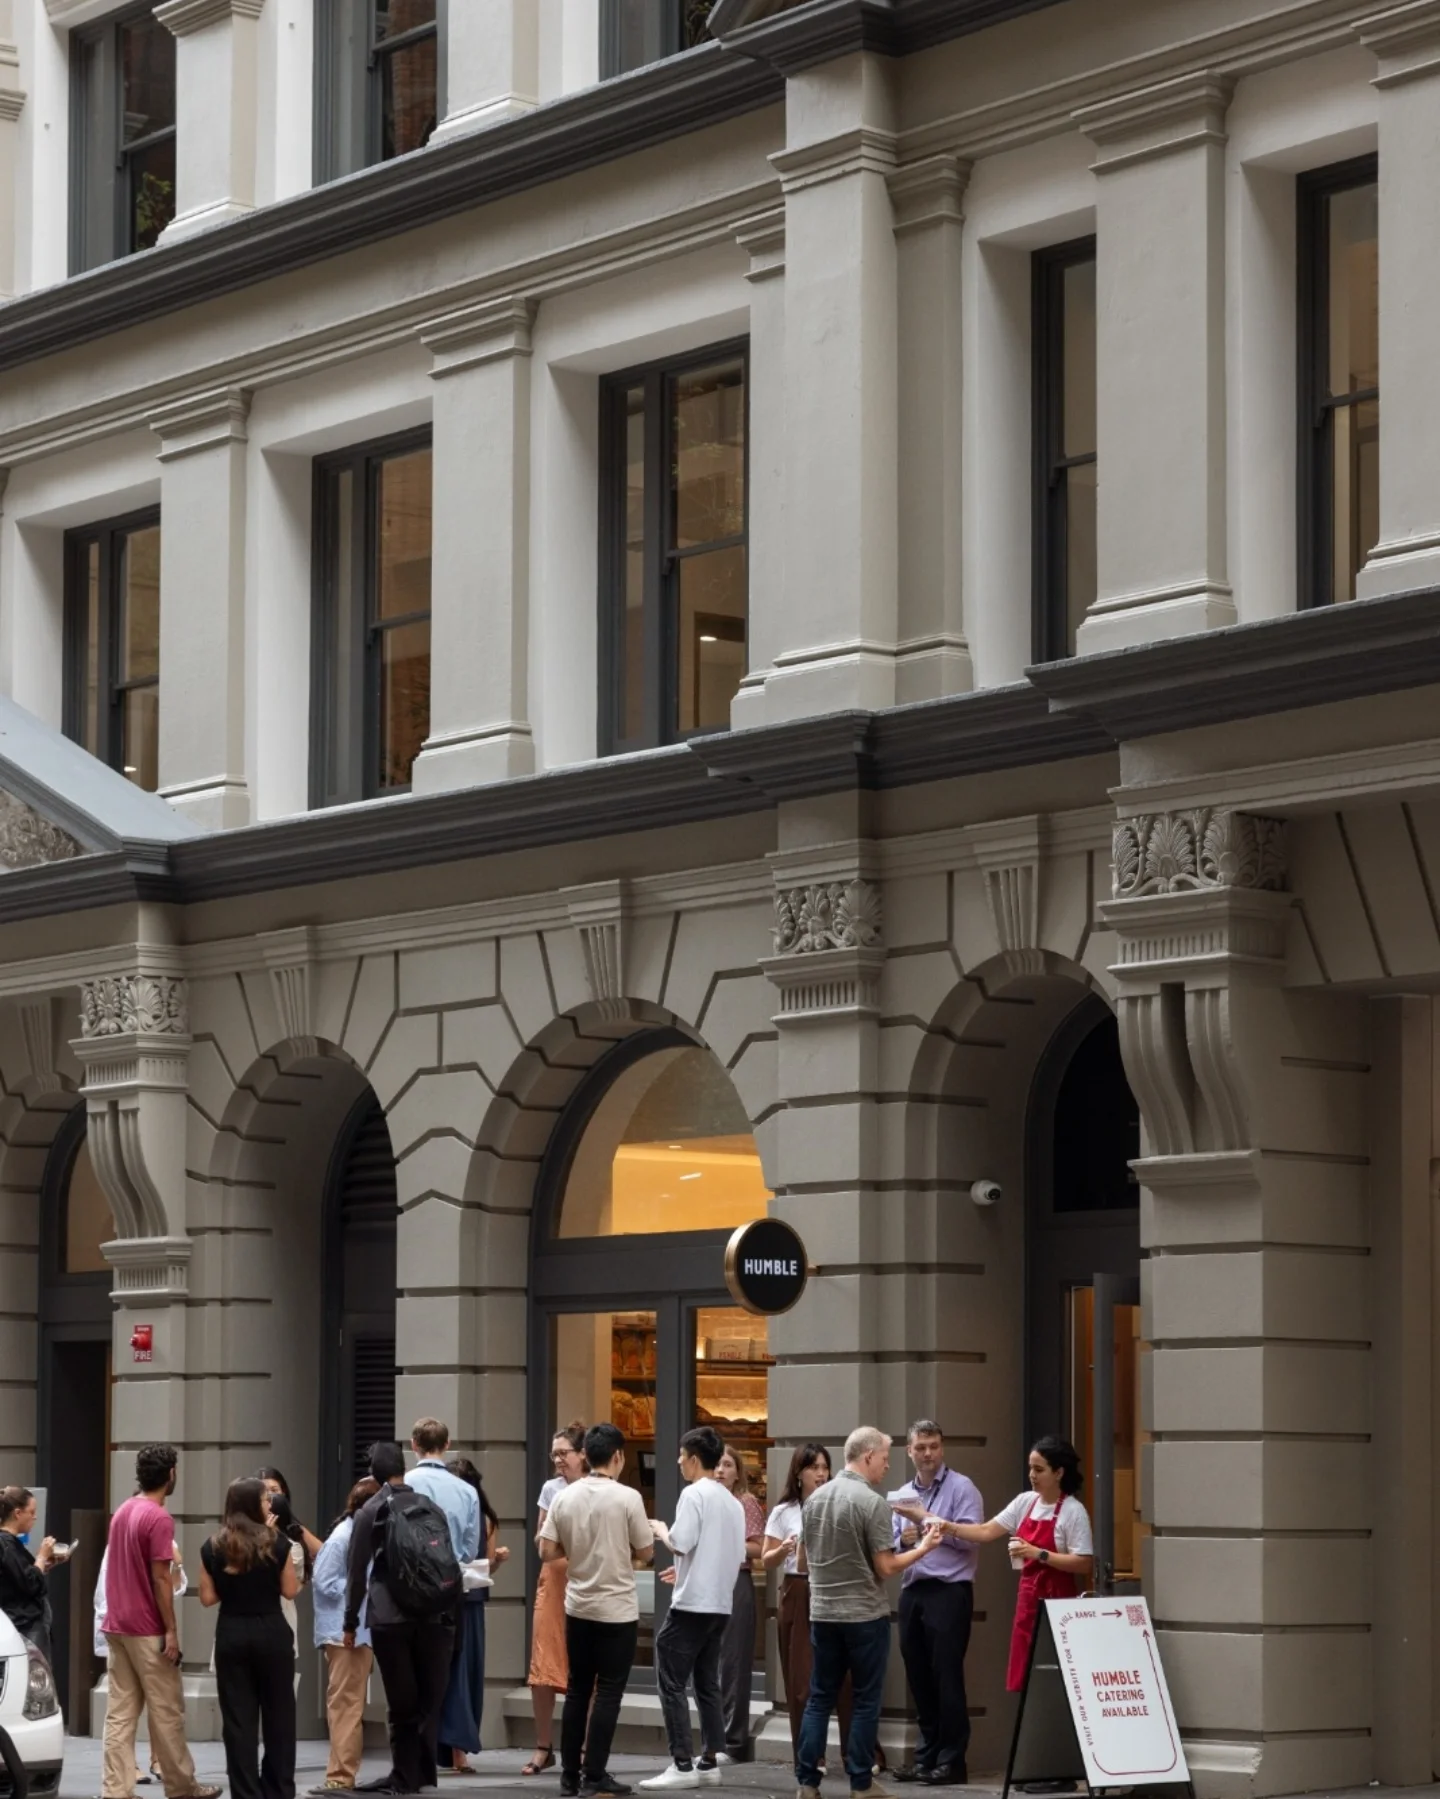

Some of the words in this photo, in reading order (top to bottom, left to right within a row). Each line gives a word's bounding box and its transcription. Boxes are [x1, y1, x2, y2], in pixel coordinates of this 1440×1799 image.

[744, 1259, 797, 1275] HUMBLE
[134, 1350, 152, 1361] FIRE
[1059, 1612, 1073, 1627] FULL
[1060, 1631, 1068, 1644] THE
[1065, 1649, 1073, 1664] FOR
[1070, 1668, 1082, 1701] WEBSITE
[1091, 1670, 1141, 1686] HUMBLE
[1096, 1689, 1145, 1703] CATERING
[1079, 1706, 1088, 1721] OUR
[1102, 1706, 1149, 1718] AVAILABLE
[1084, 1726, 1093, 1746] VISIT
